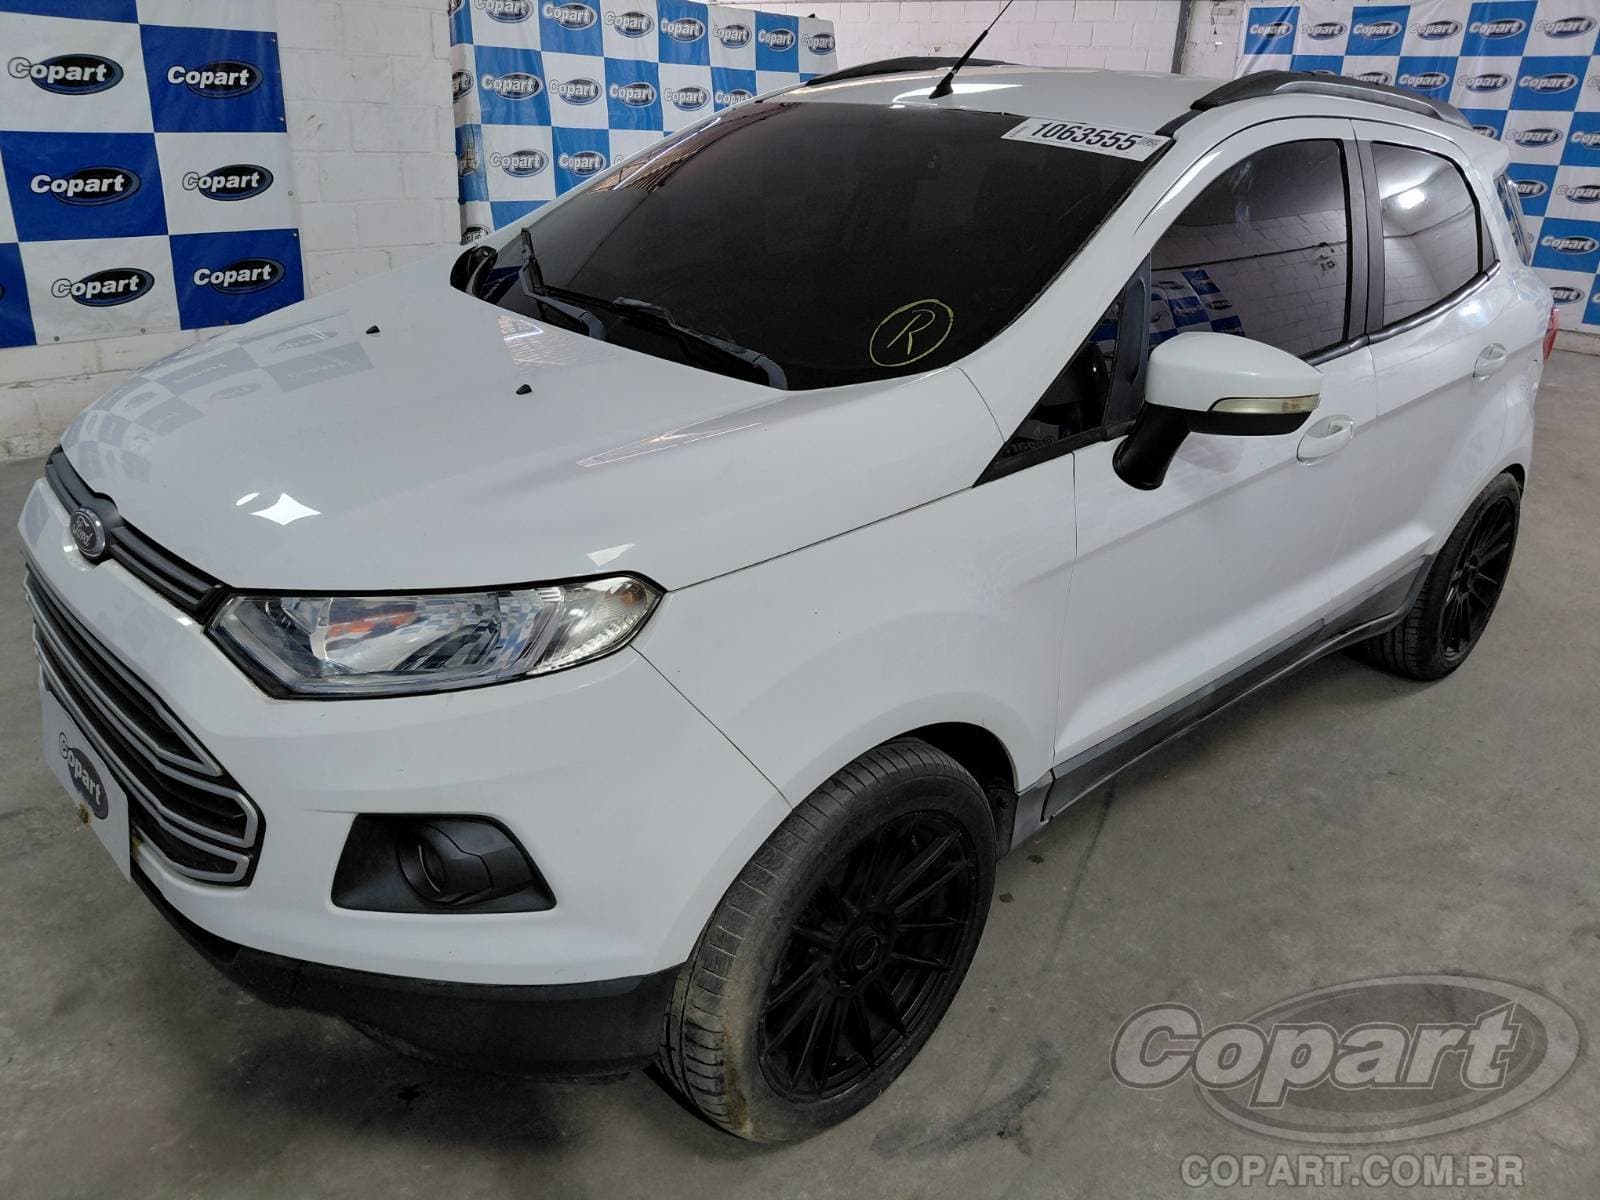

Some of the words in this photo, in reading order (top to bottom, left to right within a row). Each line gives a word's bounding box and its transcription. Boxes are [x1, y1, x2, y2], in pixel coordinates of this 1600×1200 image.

[475, 0, 528, 16] Copart
[544, 5, 591, 23] Copart
[606, 13, 649, 31] Copart
[661, 20, 699, 37] Copart
[1251, 24, 1289, 37] Copart
[1354, 24, 1397, 37] Copart
[1410, 22, 1456, 37] Copart
[1470, 21, 1520, 35] Copart
[1536, 18, 1588, 35] Copart
[713, 26, 748, 43] Copart
[759, 30, 793, 46] Copart
[1302, 25, 1340, 37] Copart
[802, 35, 835, 51] Copart
[8, 58, 107, 84] Copart
[168, 66, 250, 88] Copart
[482, 75, 536, 94] Copart
[550, 80, 596, 98] Copart
[1400, 74, 1445, 88] Copart
[1458, 75, 1506, 88] Copart
[1520, 76, 1575, 90] Copart
[609, 84, 653, 102] Copart
[664, 88, 705, 107] Copart
[1031, 122, 1143, 151] 1063555
[1507, 129, 1557, 144] Copart
[491, 153, 541, 170] Copart
[559, 153, 601, 170] Copart
[31, 174, 125, 197] Copart
[183, 172, 260, 191] Copart
[1542, 235, 1595, 251] Copart
[193, 264, 272, 288] Copart
[52, 274, 141, 299] Copart
[72, 515, 94, 547] Ford
[58, 731, 101, 806] Copart
